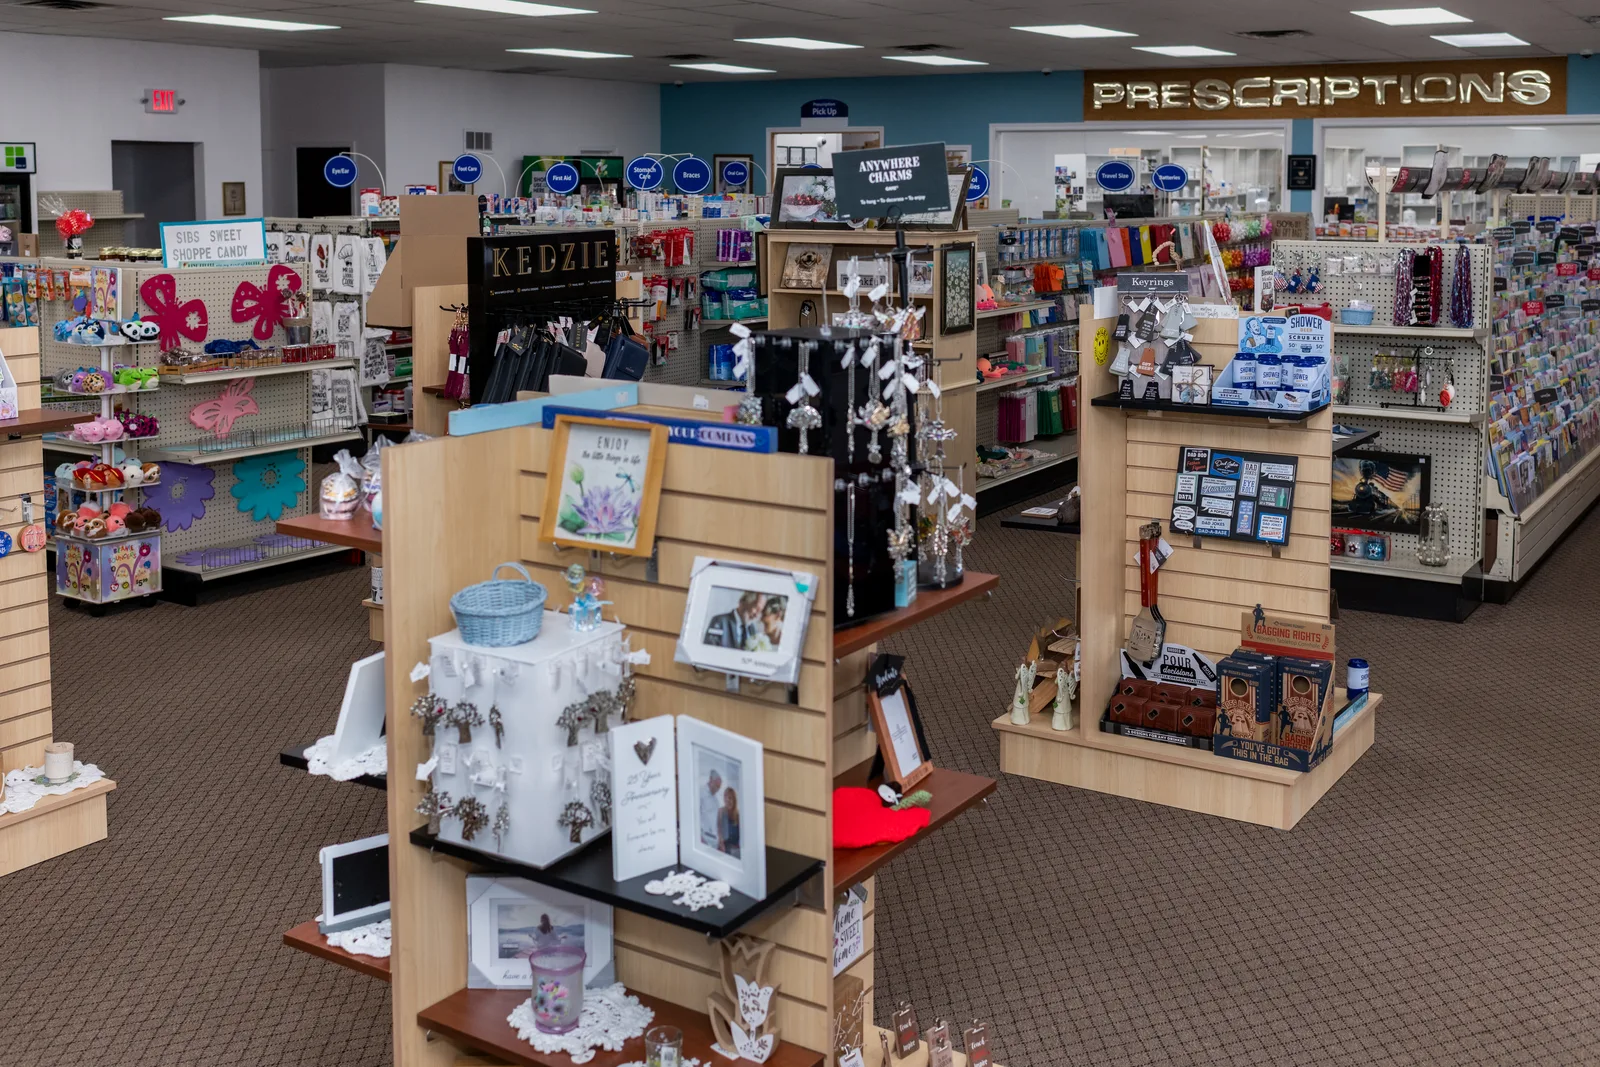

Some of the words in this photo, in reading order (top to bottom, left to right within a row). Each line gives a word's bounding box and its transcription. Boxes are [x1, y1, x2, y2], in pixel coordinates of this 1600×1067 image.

[1092, 69, 1552, 111] PRESCRIPTIONS
[153, 89, 175, 112] EXIT
[812, 107, 826, 116] Pick
[827, 107, 837, 116] Up
[858, 156, 921, 173] ANYWHERE
[868, 169, 913, 184] CHARMS
[176, 230, 200, 244] SIBS
[210, 229, 242, 242] SWEET
[172, 247, 212, 261] SHOPPE
[217, 244, 248, 258] CANDY
[492, 240, 609, 278] KEDZIE
[1132, 278, 1174, 287] Keyrings
[1290, 316, 1322, 330] SHOWER
[597, 436, 629, 450] ENJOY
[700, 429, 754, 444] COMPASS
[1257, 624, 1290, 638] BAGGING
[1293, 630, 1321, 642] RIGHTS
[1277, 638, 1297, 646] Tabletop
[1298, 640, 1320, 648] Cornhole
[1163, 654, 1191, 668] POUR
[1162, 666, 1194, 677] decisions
[1285, 732, 1314, 746] BAGGIN
[1240, 740, 1264, 753] YOU'VE
[1267, 746, 1280, 756] GOT
[1232, 747, 1249, 758] THIS
[1250, 751, 1257, 759] IN
[1259, 752, 1272, 763] THE
[1274, 756, 1288, 766] BAG
[835, 908, 855, 933] home
[840, 919, 860, 947] SWEET
[834, 944, 852, 968] home
[502, 970, 520, 980] have
